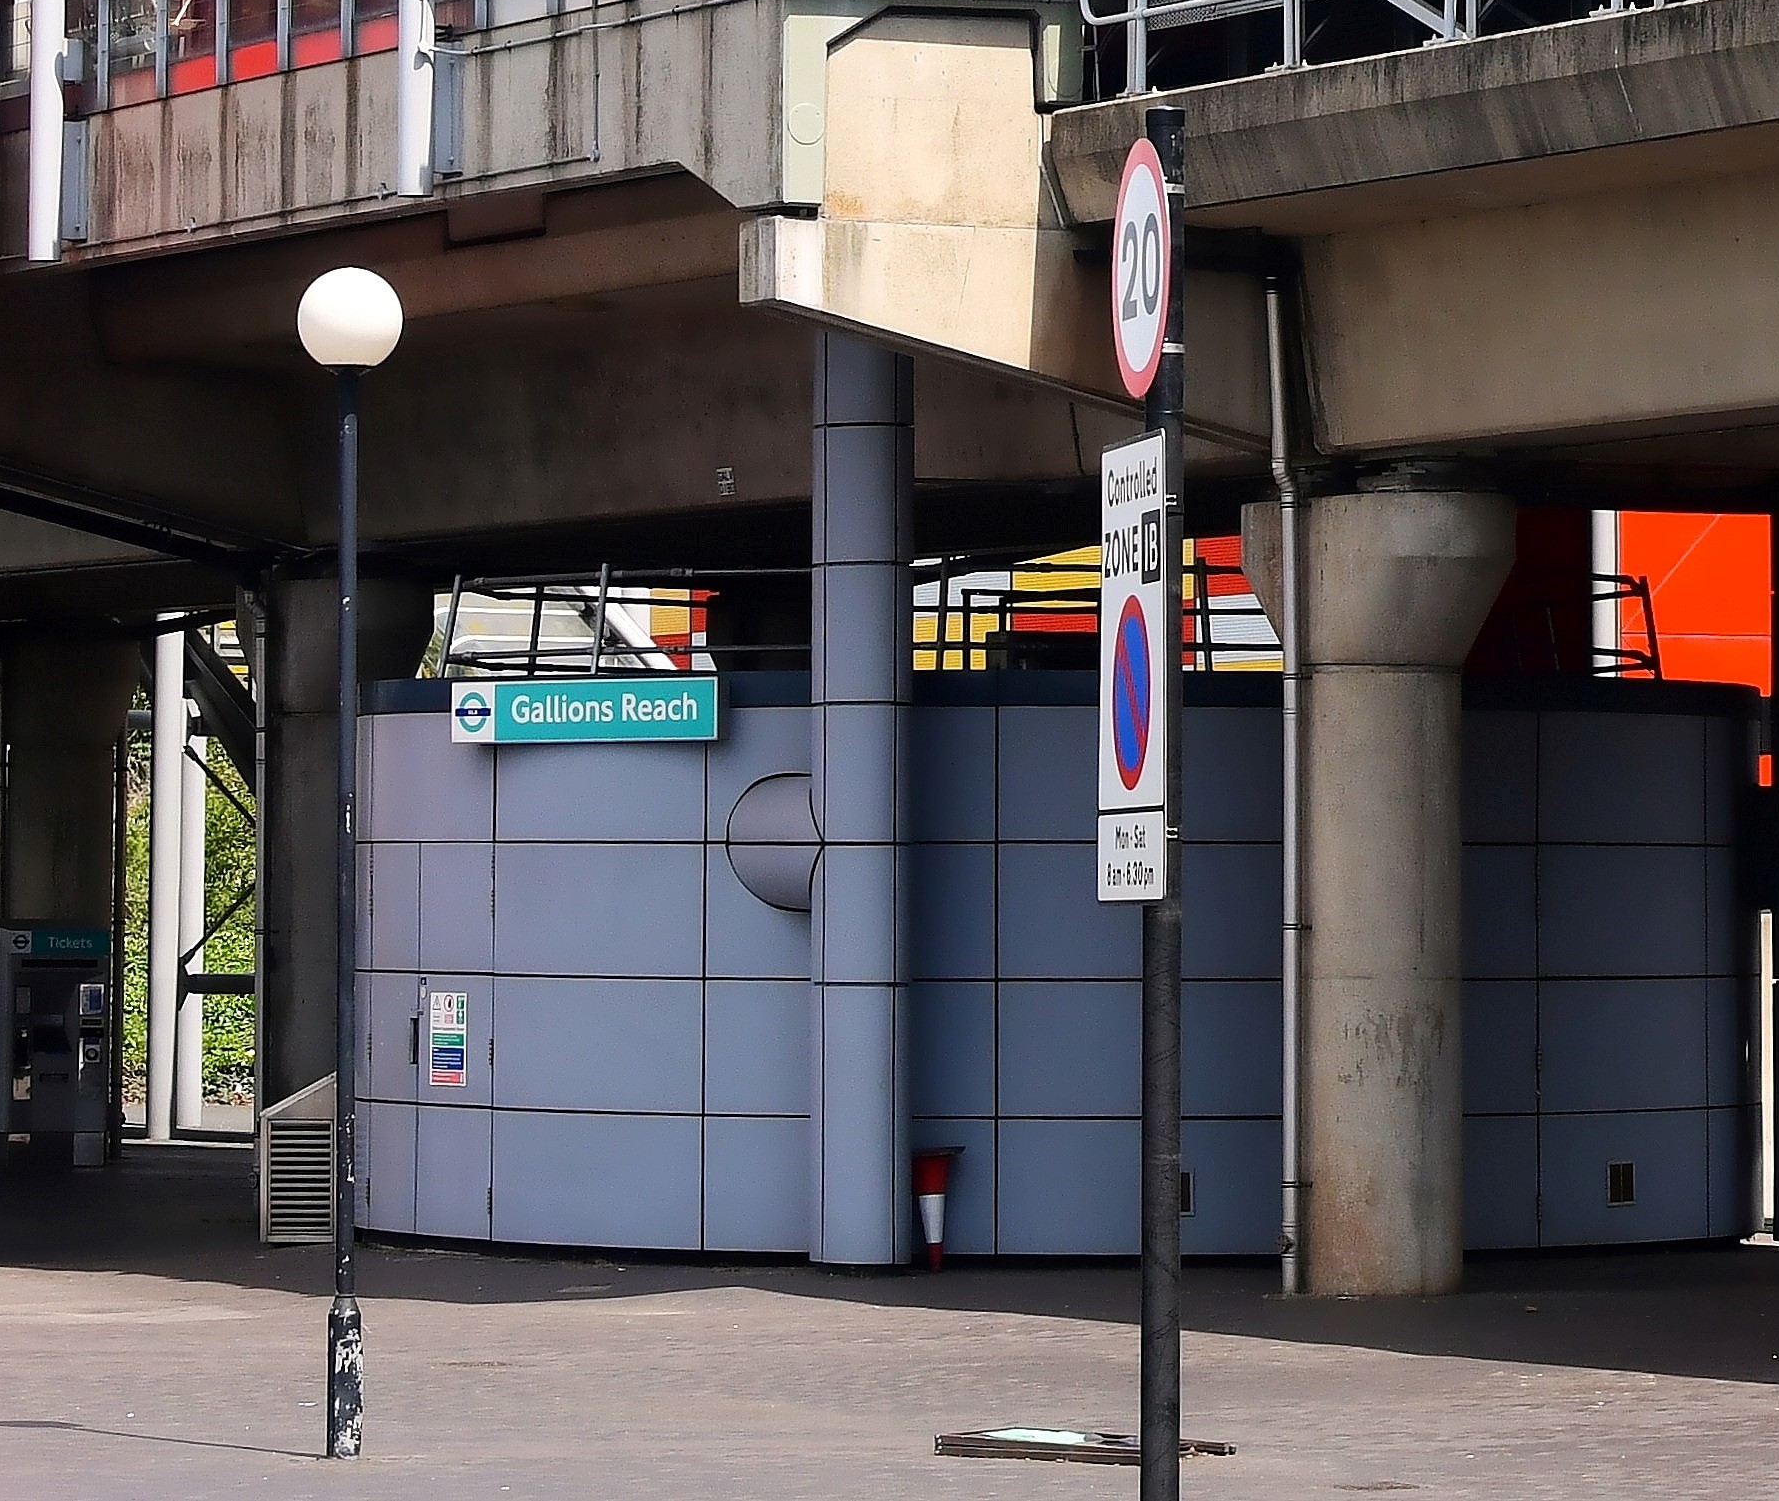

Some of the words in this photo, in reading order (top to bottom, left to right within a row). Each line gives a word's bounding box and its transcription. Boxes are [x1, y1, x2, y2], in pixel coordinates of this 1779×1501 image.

[1121, 211, 1161, 322] 20
[1107, 456, 1158, 508] Controlled
[1104, 524, 1139, 579] ZONE
[510, 694, 614, 724] Gallions
[620, 691, 698, 722] Reach
[48, 936, 94, 949] Tickets
